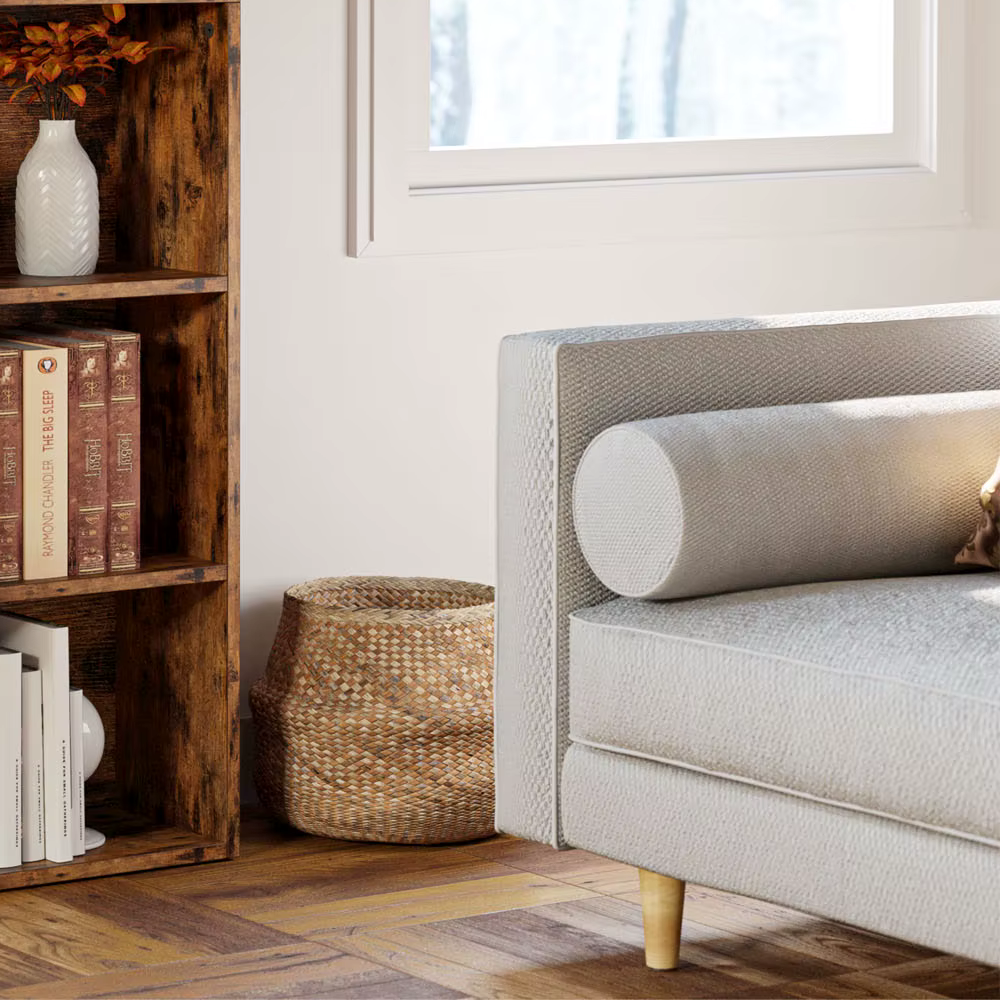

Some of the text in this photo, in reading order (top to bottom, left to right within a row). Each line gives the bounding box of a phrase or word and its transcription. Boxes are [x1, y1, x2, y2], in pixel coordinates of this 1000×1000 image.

[42, 390, 54, 557] RAYMOND CHANDLER THE BIG SLEEP
